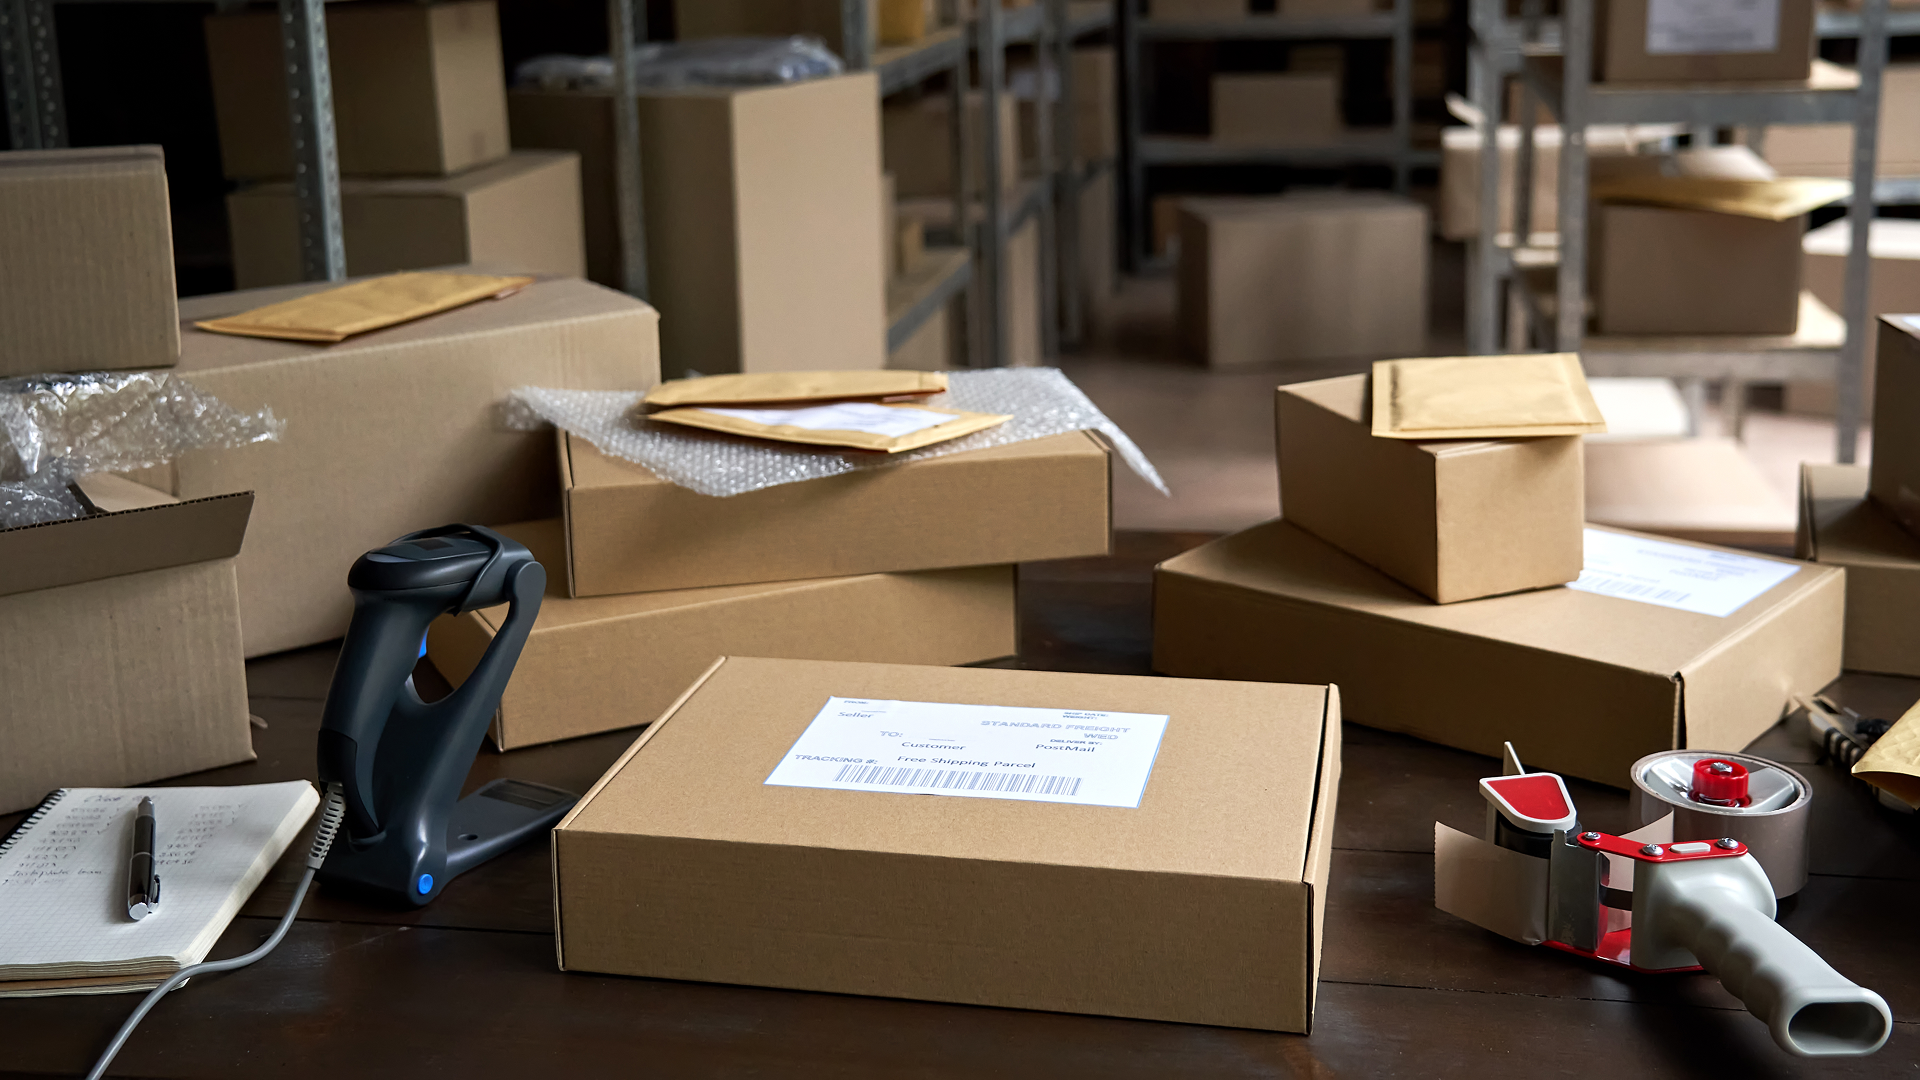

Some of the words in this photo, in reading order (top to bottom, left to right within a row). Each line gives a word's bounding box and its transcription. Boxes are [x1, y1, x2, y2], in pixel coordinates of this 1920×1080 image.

[980, 720, 1062, 729] STANDARD
[1065, 724, 1131, 733] FREIGHT
[1083, 732, 1119, 740] WED
[901, 741, 966, 750] Customer
[1035, 744, 1096, 753] PostMail
[795, 754, 864, 764] TRACKING
[931, 757, 989, 768] Shipping
